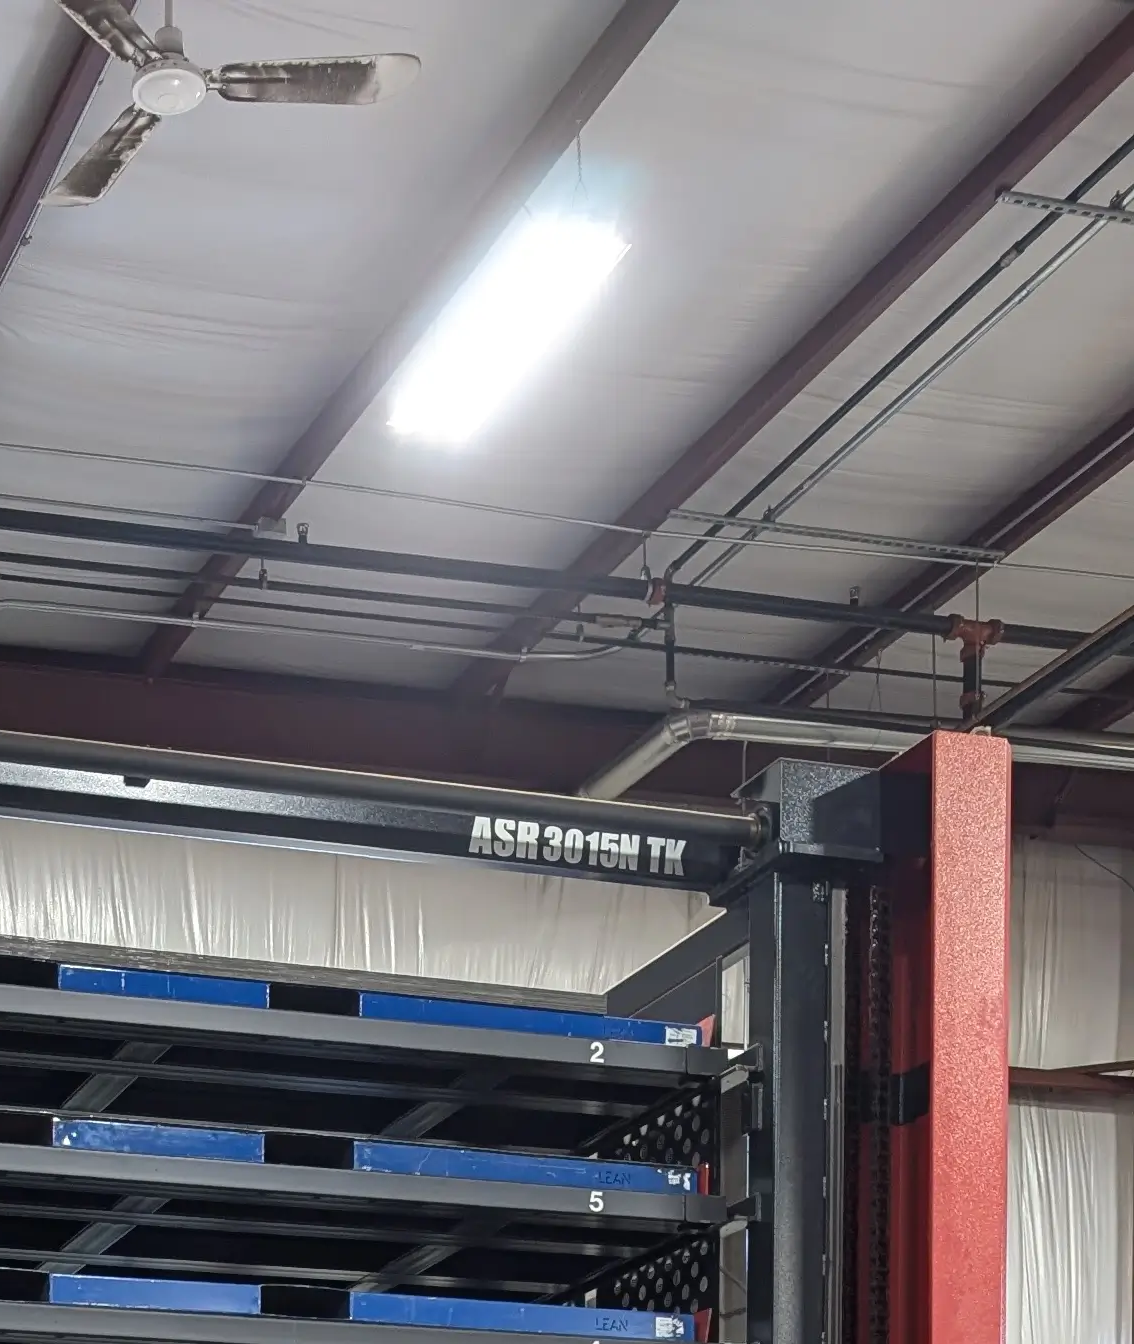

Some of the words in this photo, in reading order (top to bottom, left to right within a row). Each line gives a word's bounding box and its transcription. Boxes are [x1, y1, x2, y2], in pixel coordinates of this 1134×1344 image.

[646, 836, 686, 876] TK
[589, 1042, 605, 1064] 2
[598, 1171, 631, 1186] LEAN
[589, 1191, 604, 1213] 5
[595, 1317, 628, 1331] LEAN
